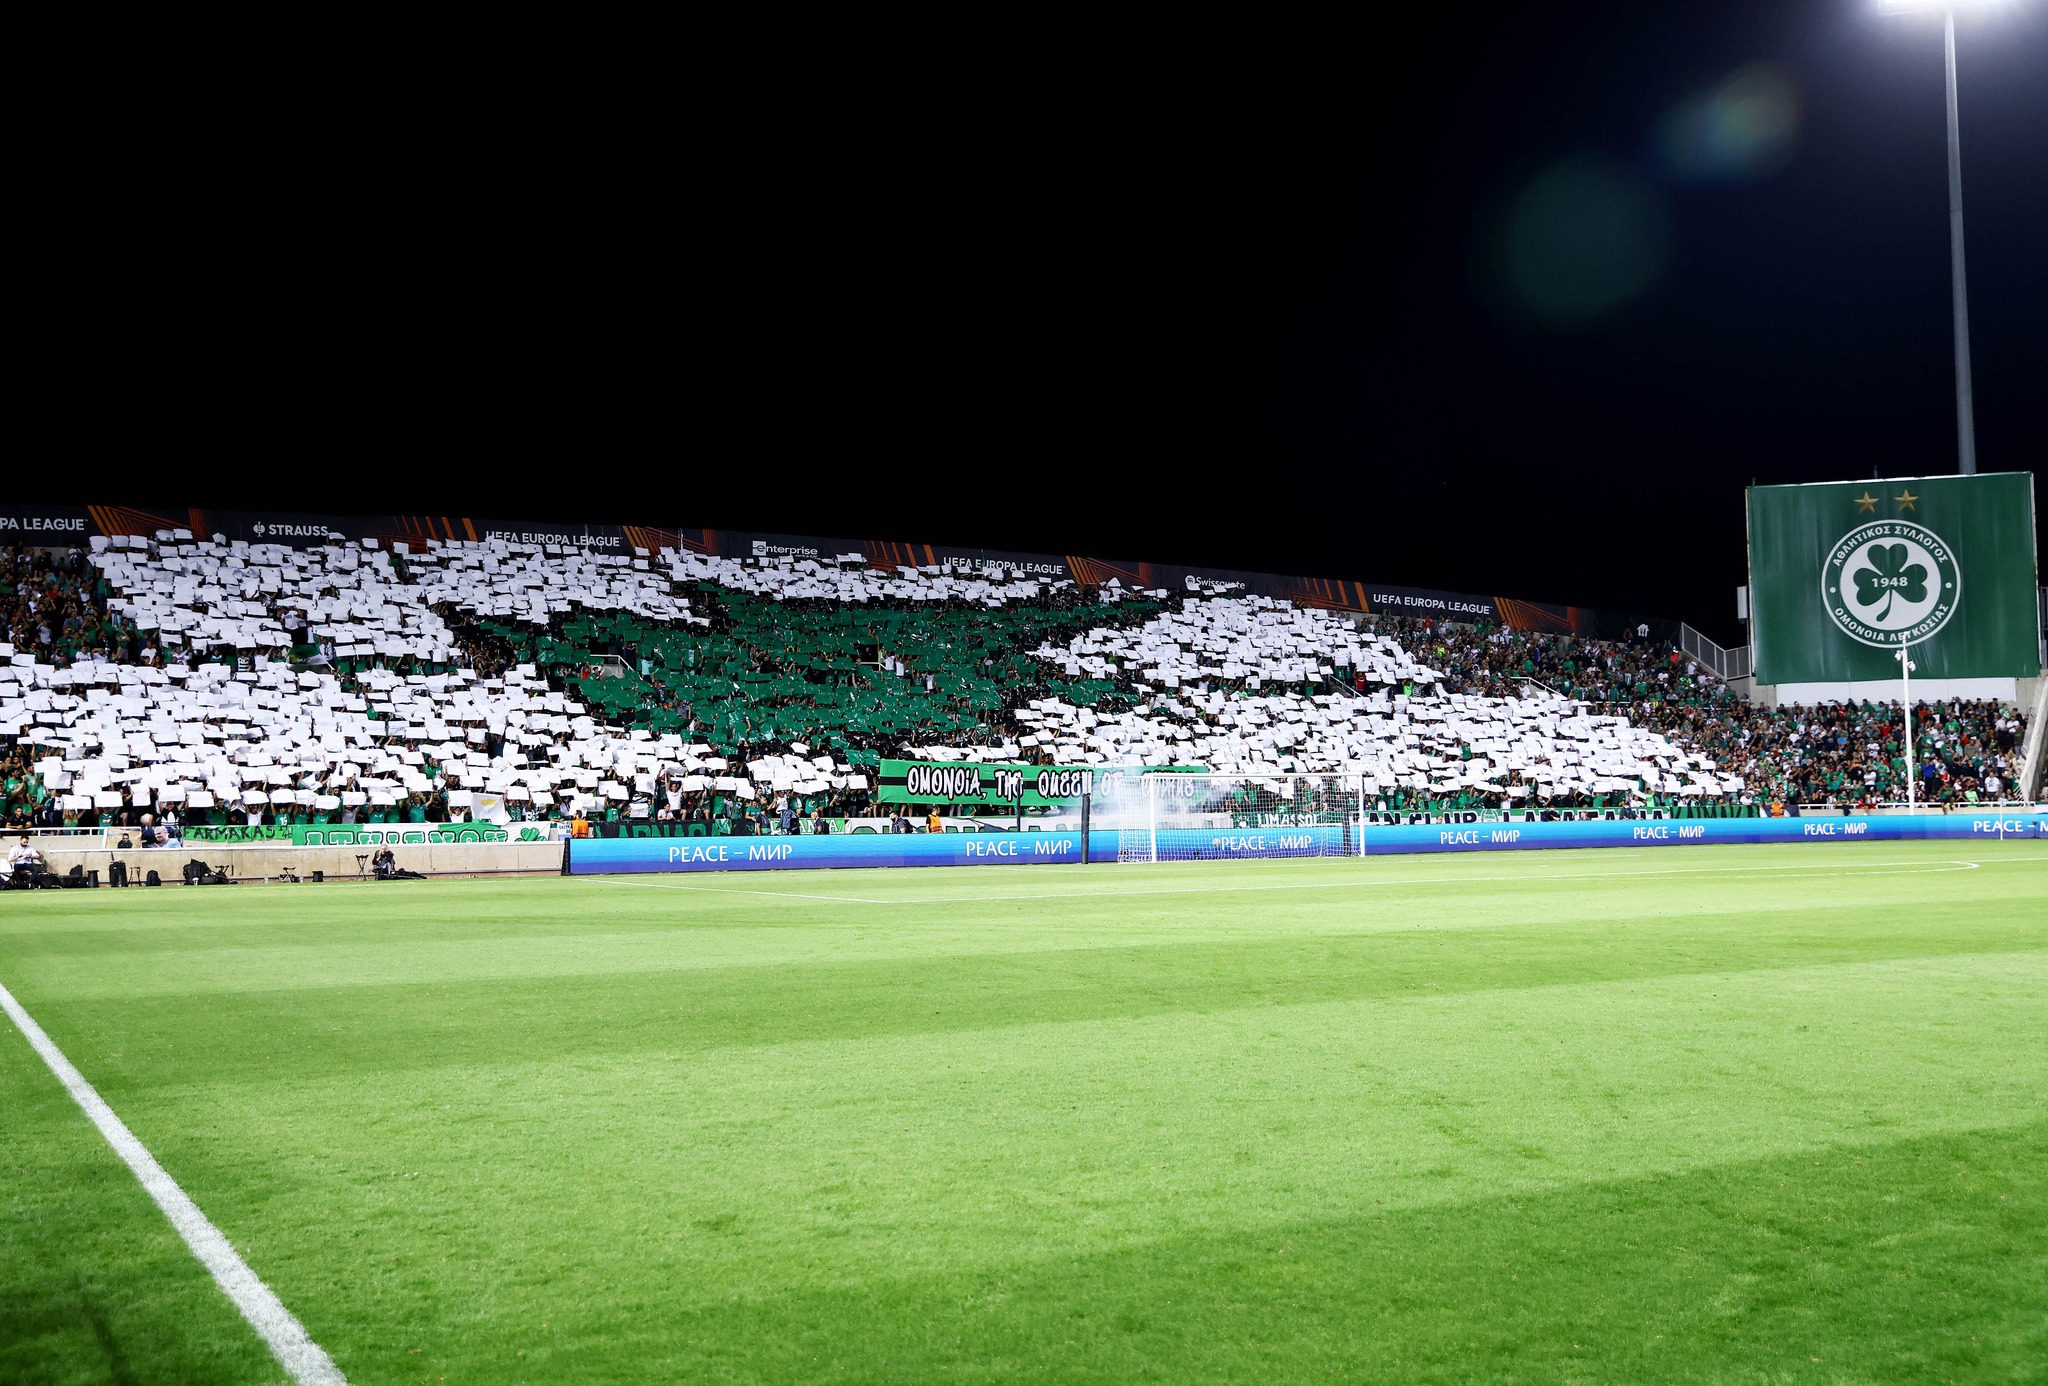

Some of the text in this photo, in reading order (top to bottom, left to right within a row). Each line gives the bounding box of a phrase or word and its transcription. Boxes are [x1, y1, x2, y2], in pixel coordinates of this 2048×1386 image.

[23, 518, 85, 531] LEAGUE
[268, 524, 328, 536] STRAUSS
[522, 532, 570, 545] EUROPA
[573, 535, 620, 547] LEAGUE
[1832, 525, 1949, 567] ΑΘΛΗΤΙΚΟΣ ΣΥΛΛΟΓΟΣ
[753, 541, 818, 556] enterprise
[943, 556, 1063, 575] UEFA EUROPA LEAGUE
[1196, 577, 1246, 590] Swisste
[1871, 576, 1909, 588] 1948
[1373, 593, 1490, 615] UEFA EUROPA LEAGUE
[1834, 607, 1885, 642] ΟΜΟΝΟΙΑ
[1633, 826, 1669, 840] PEACE
[1804, 823, 1835, 836] PEACE
[1973, 820, 2024, 833] PEACE
[1221, 835, 1266, 850] PEACE
[1440, 830, 1480, 845] PEACE
[669, 845, 729, 863] PEACE
[966, 840, 1018, 857] PEACE
